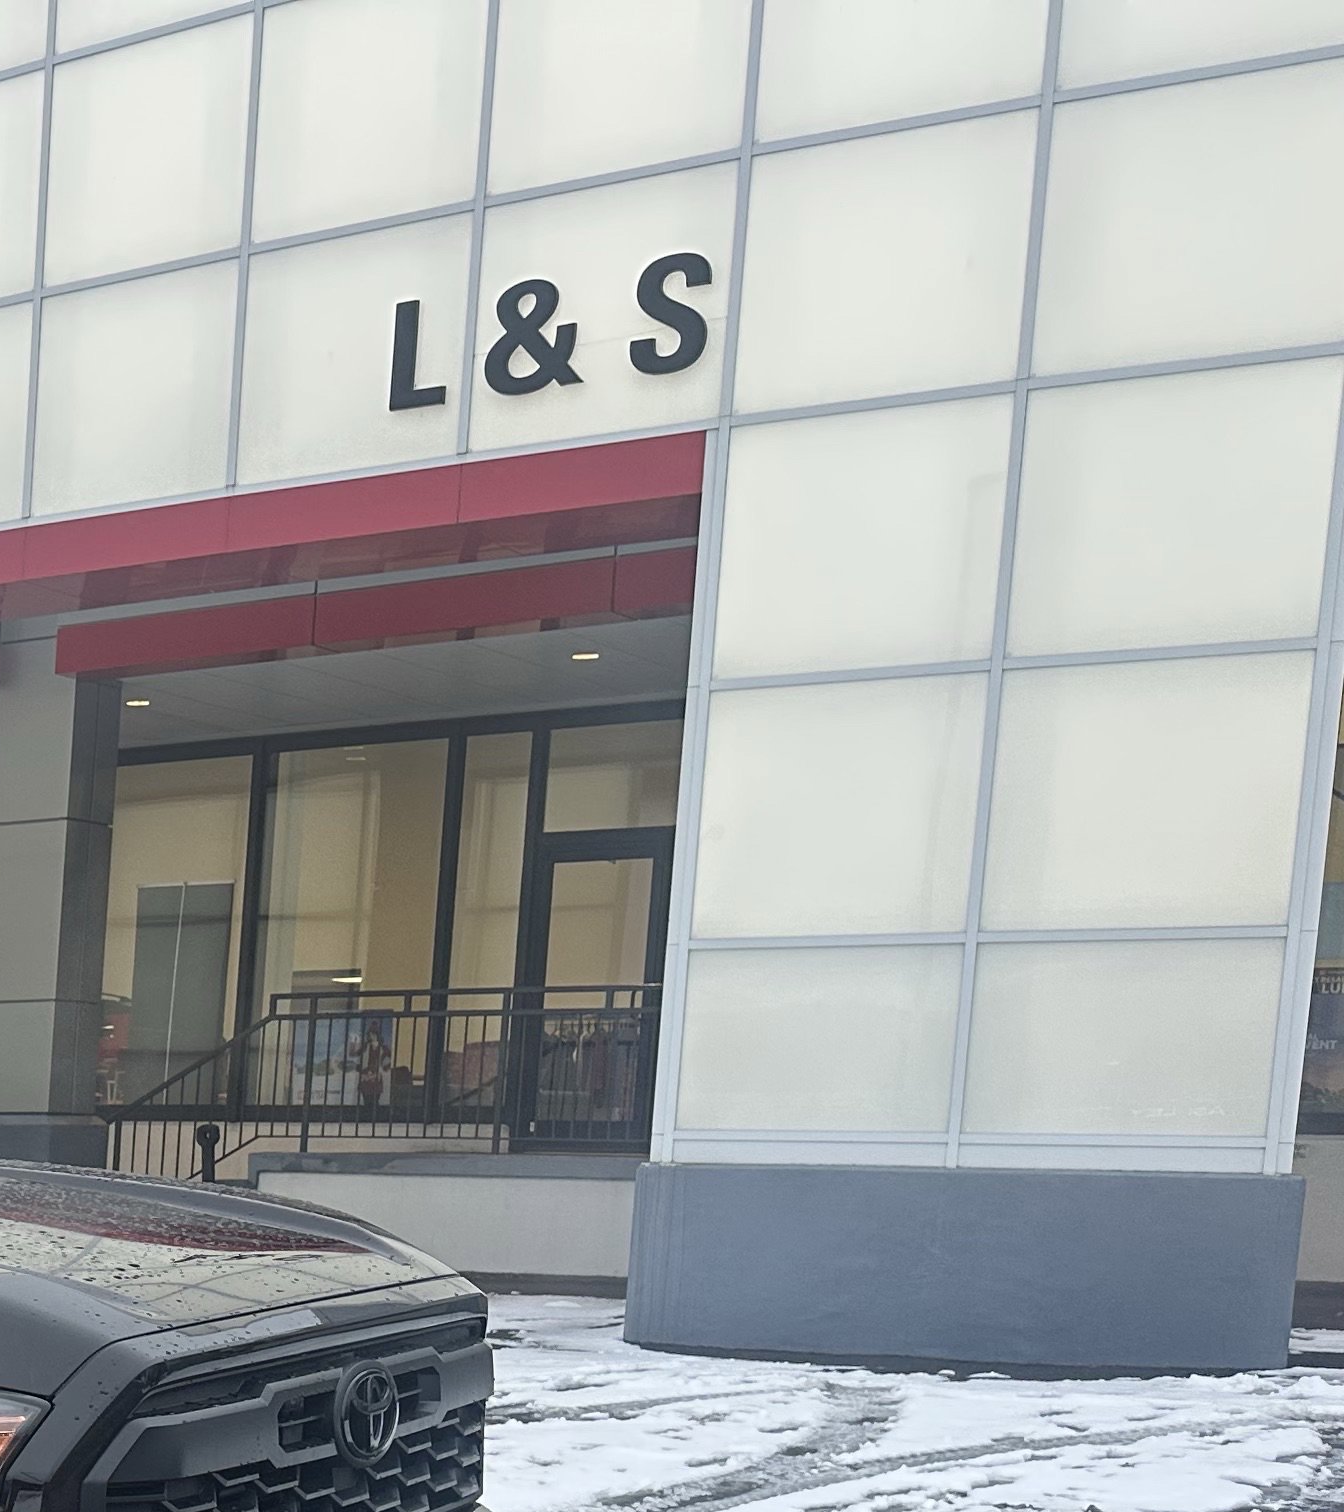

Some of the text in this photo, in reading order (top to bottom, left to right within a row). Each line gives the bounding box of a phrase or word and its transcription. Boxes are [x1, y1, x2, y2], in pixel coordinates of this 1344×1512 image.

[389, 252, 712, 411] L & S
